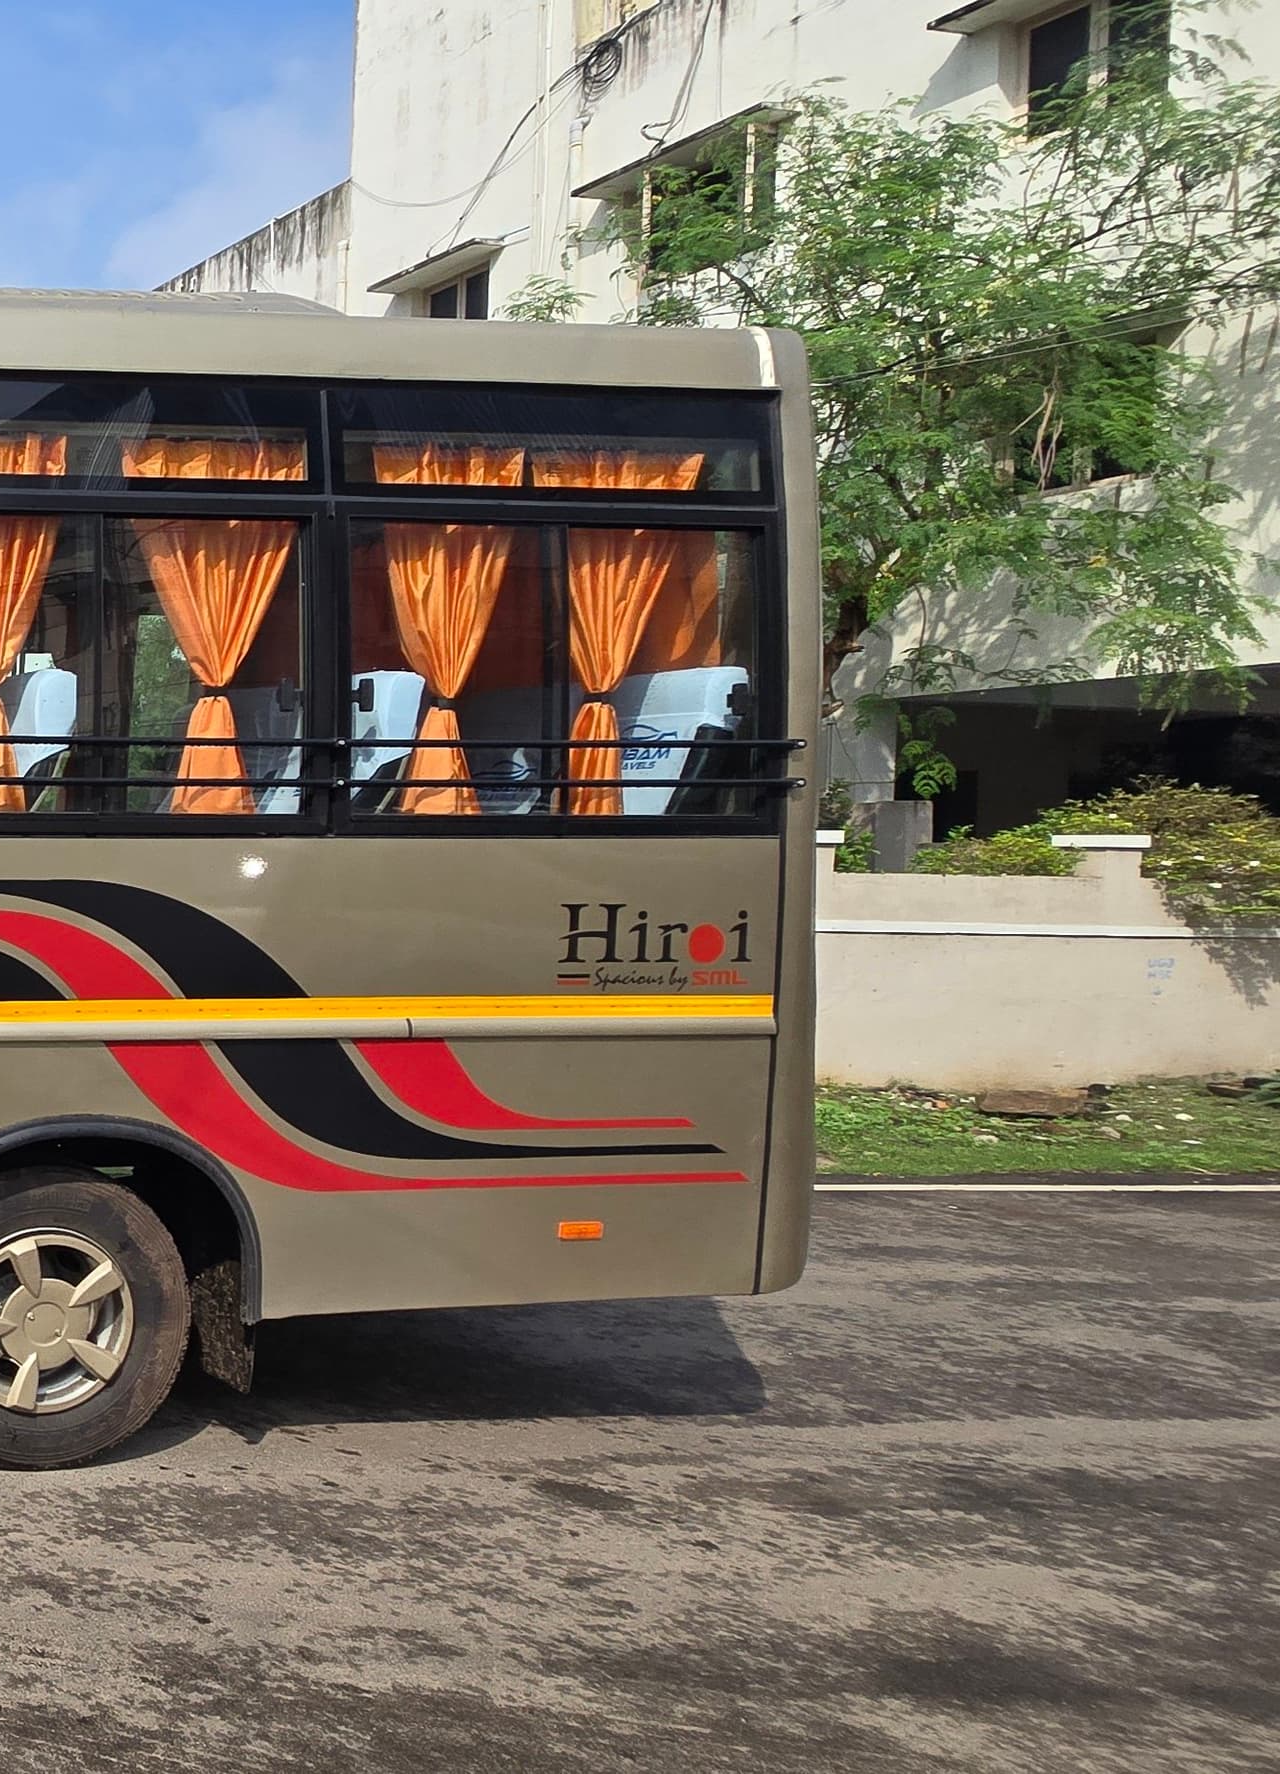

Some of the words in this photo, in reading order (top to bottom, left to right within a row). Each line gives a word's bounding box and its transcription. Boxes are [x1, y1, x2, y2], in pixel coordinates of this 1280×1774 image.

[557, 903, 752, 964] Hiroi
[593, 966, 664, 992] Spacious
[669, 966, 689, 992] by
[692, 970, 749, 986] SML
